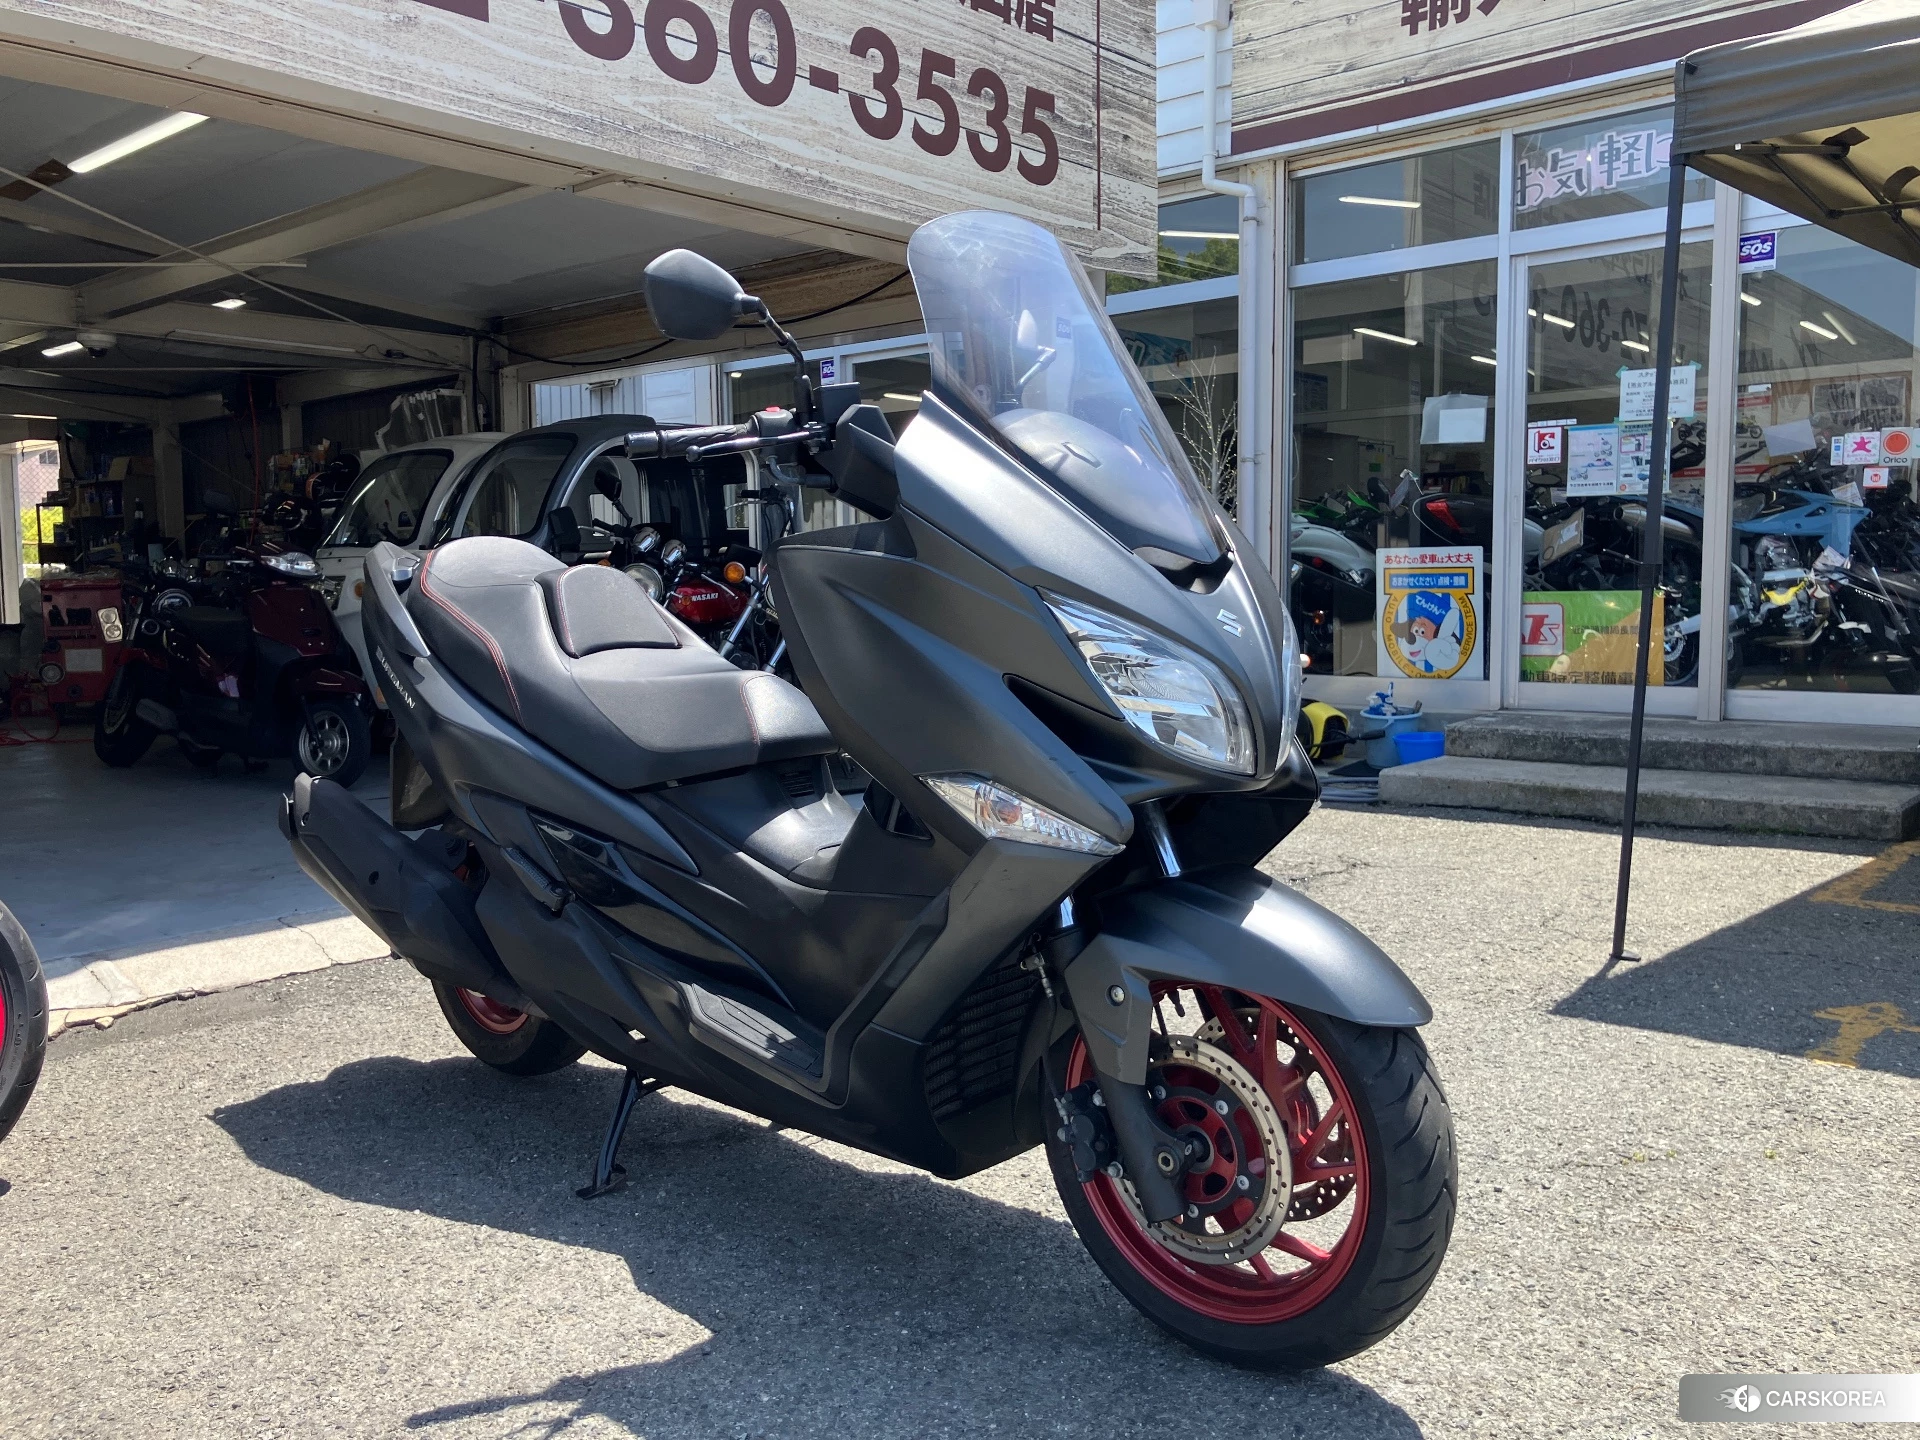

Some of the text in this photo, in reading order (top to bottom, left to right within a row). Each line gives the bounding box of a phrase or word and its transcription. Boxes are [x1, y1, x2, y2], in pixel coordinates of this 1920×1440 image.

[1515, 132, 1673, 207] お気軽に
[1740, 242, 1772, 256] SOS
[1883, 456, 1908, 464] Orico
[1384, 552, 1474, 564] あなたの愛車は大丈夫
[692, 592, 719, 602] WASAKI
[1458, 595, 1474, 657] SERVICE TEAM
[1385, 596, 1411, 672] AUTO MOBILE
